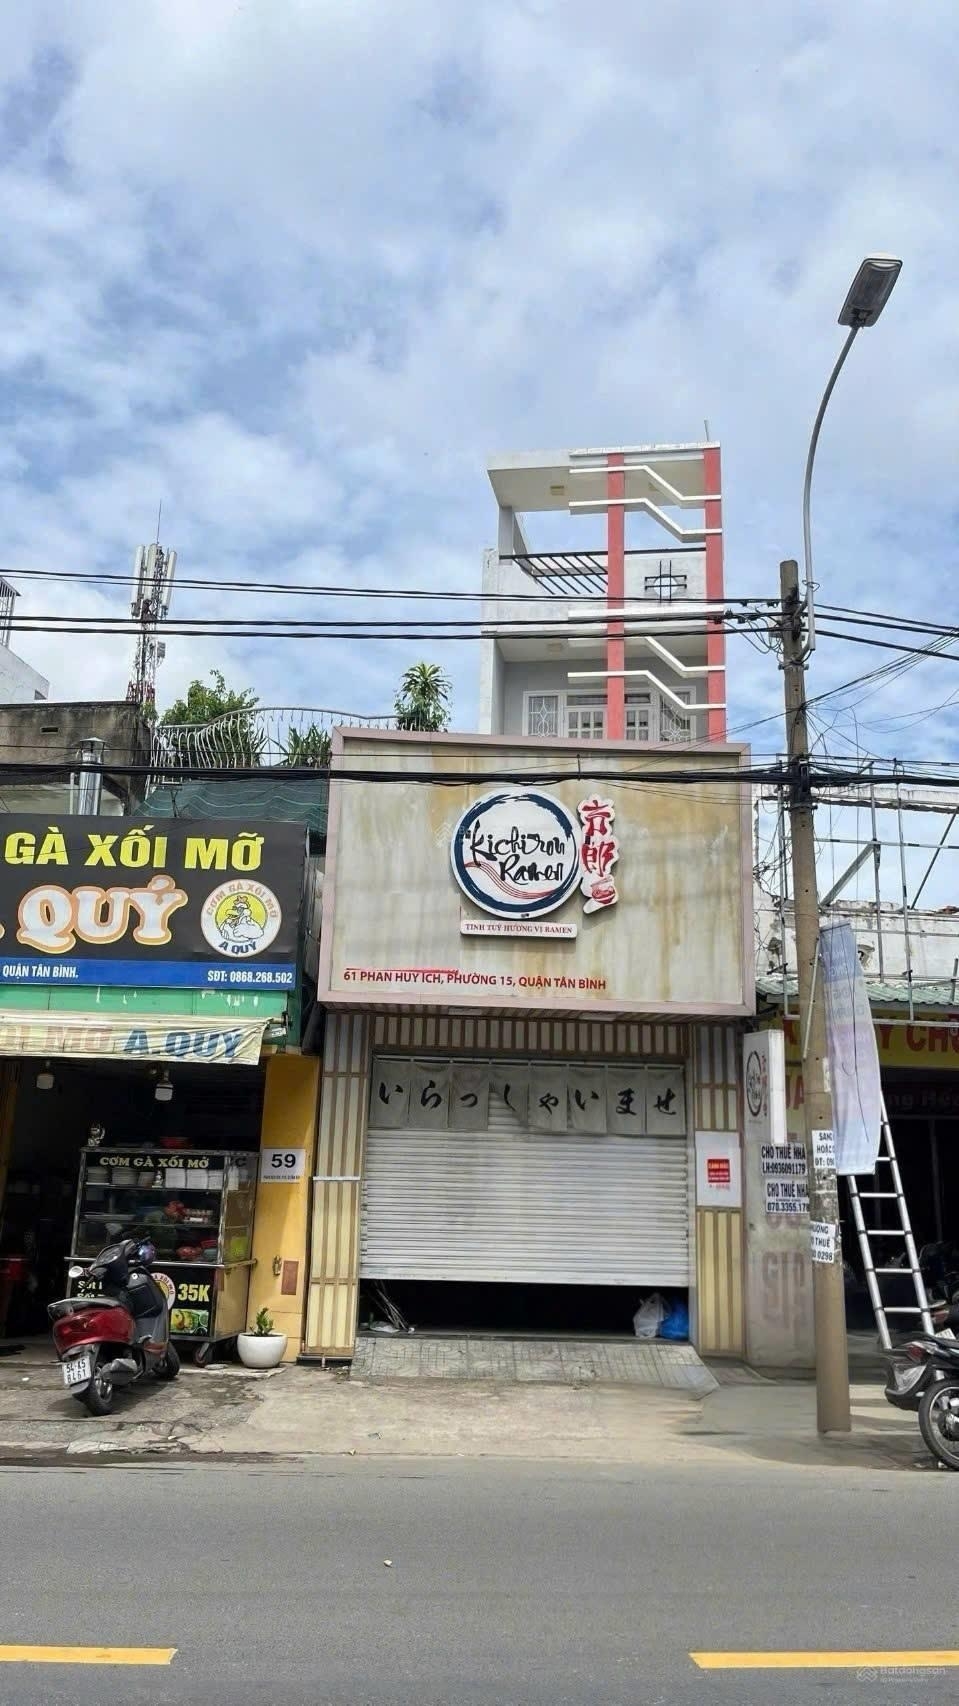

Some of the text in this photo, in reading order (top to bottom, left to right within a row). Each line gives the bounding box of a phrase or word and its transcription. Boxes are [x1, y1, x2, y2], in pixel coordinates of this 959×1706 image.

[4, 824, 265, 872] GÀ XỐI MỠ
[500, 854, 564, 885] Ramen
[219, 941, 229, 952] A
[2, 963, 29, 979] QUẬN
[31, 964, 51, 977] TÂN
[207, 969, 293, 984] SĐT: 0868.268.502
[344, 971, 356, 981] 61
[360, 971, 392, 982] PHAN
[395, 972, 419, 983] HUY
[447, 972, 497, 985] PHƯỜNG
[500, 976, 516, 987] 15,
[518, 976, 552, 990] QUẬN
[553, 976, 576, 989] TÂN
[578, 977, 606, 990] BÌNH
[761, 1146, 774, 1159] CHO
[775, 1143, 792, 1160] THUÊ
[100, 1156, 130, 1167] CƠM
[133, 1156, 154, 1167] GÀ
[271, 1153, 296, 1168] 59
[767, 1182, 779, 1197] CHO
[177, 1283, 211, 1302] 35K
